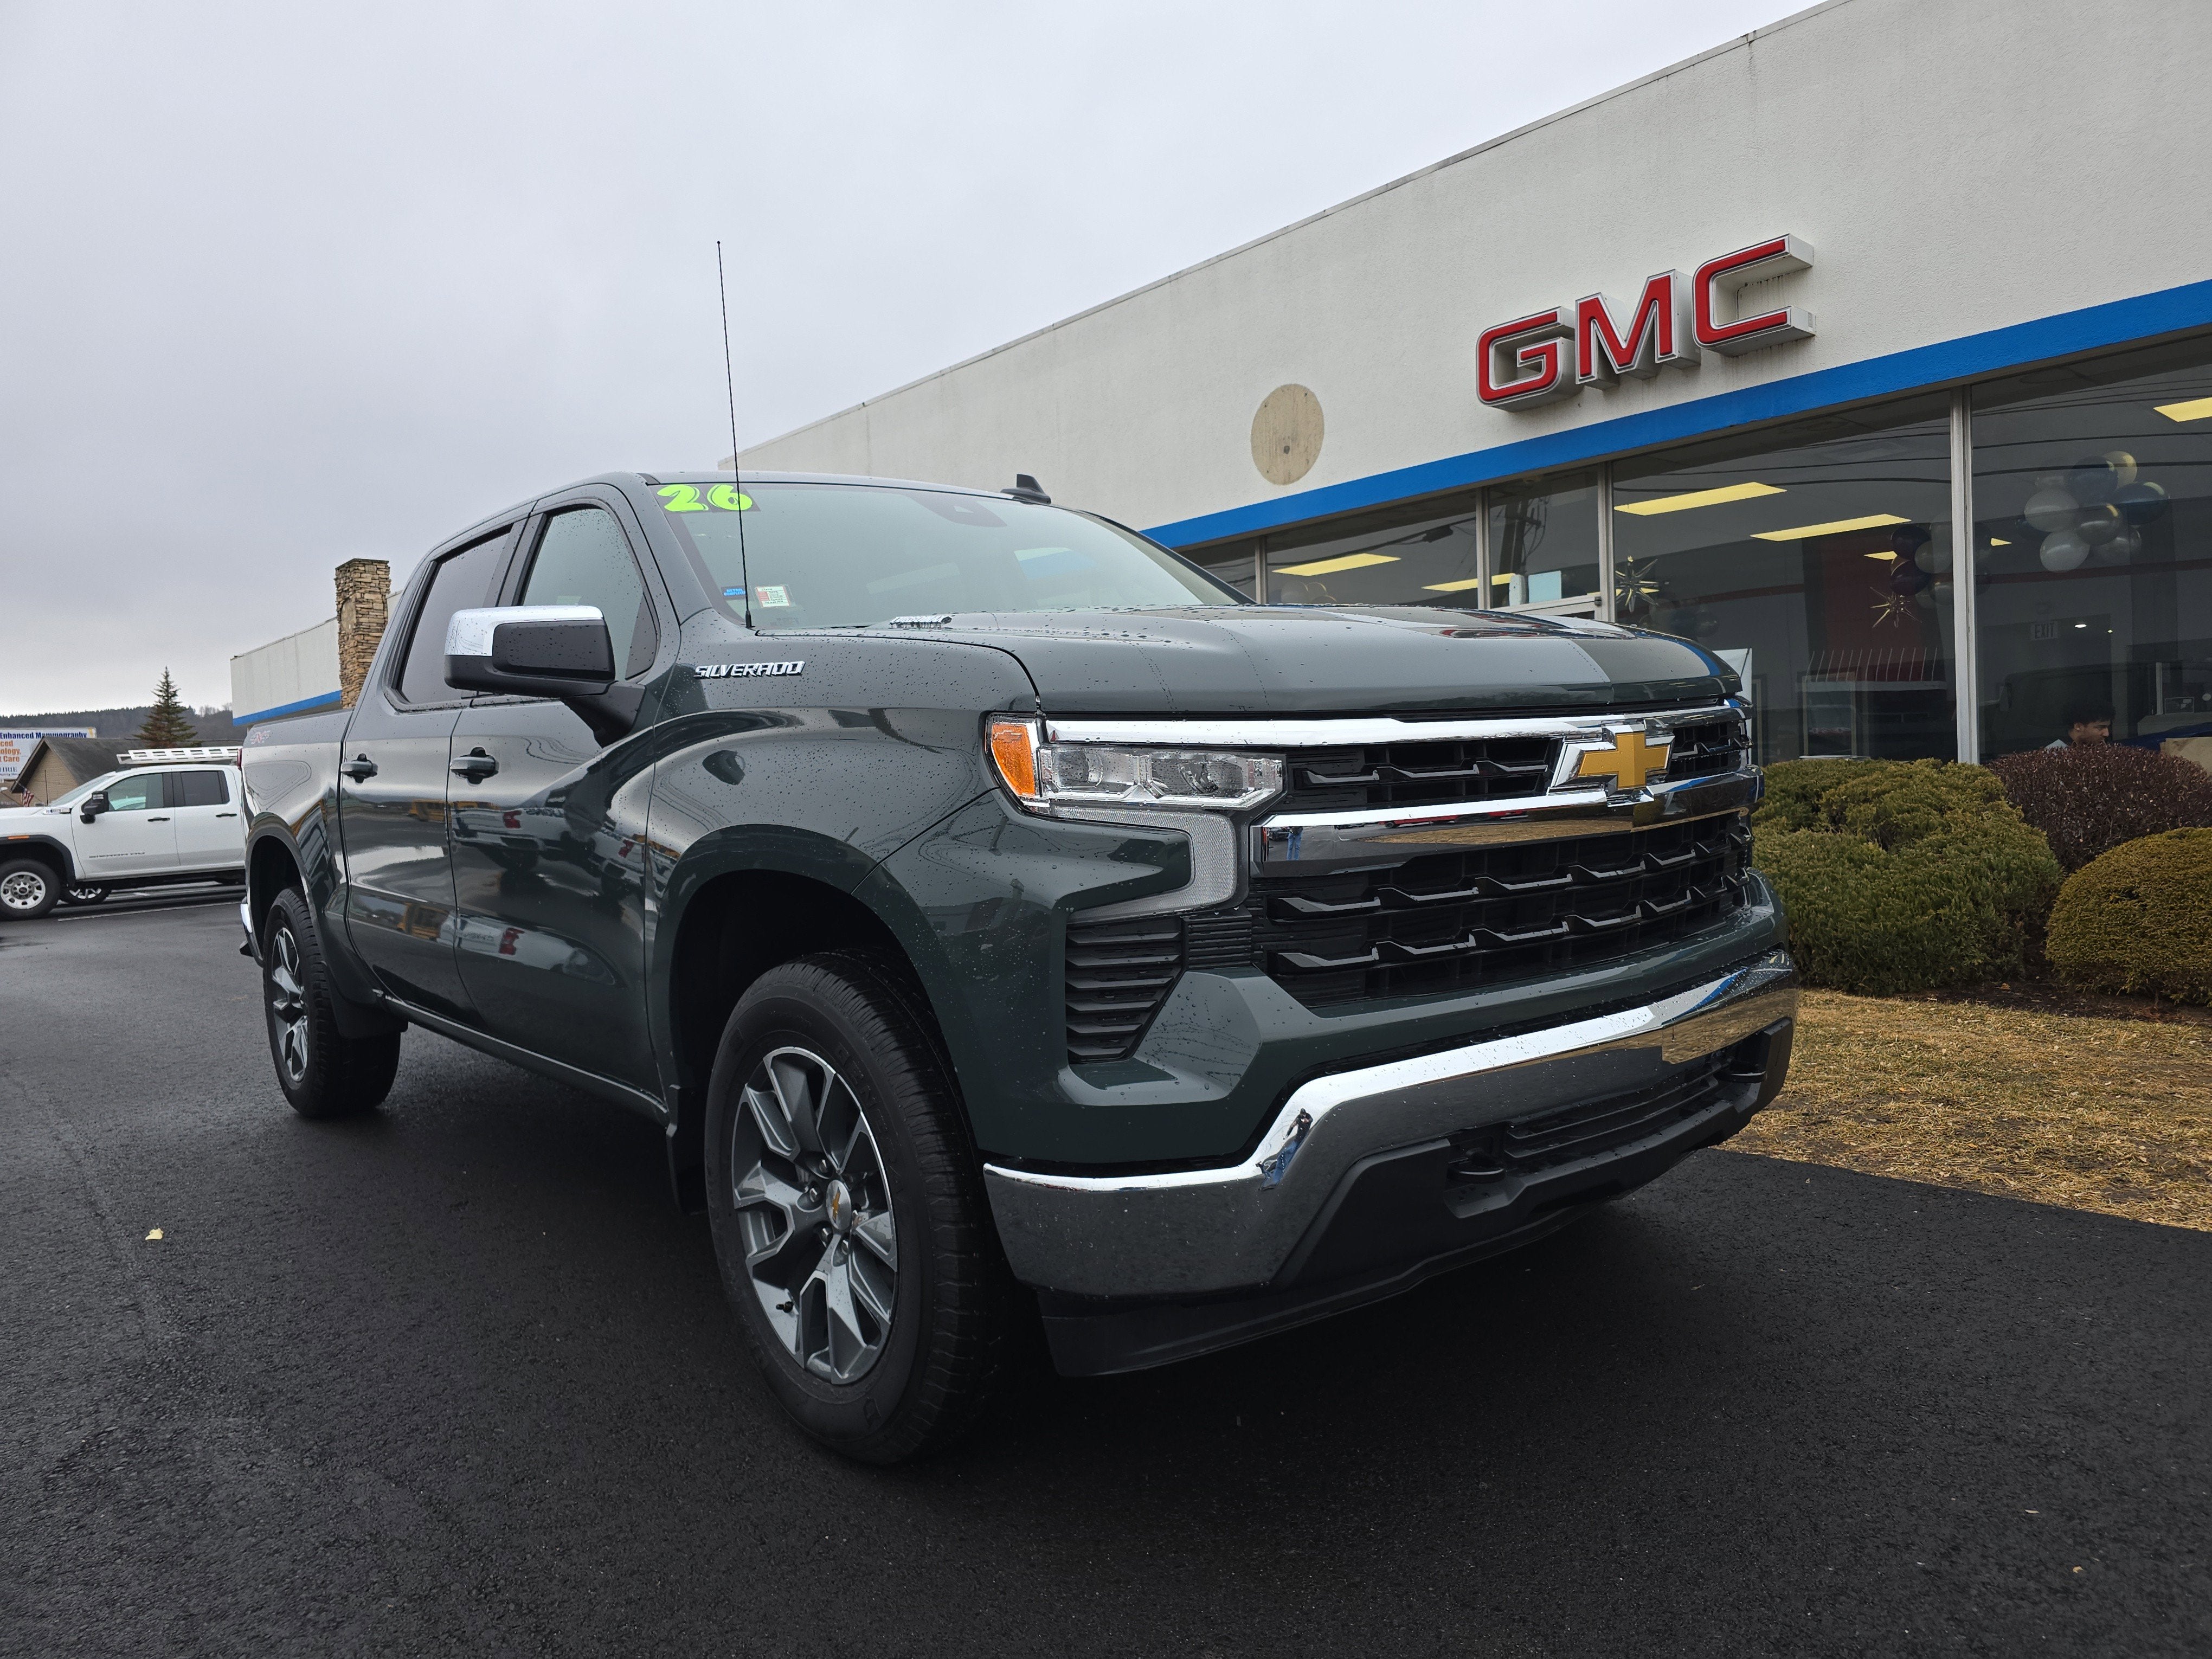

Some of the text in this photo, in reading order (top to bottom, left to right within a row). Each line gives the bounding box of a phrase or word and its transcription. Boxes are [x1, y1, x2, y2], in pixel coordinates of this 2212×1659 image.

[1476, 233, 1803, 409] GMC
[657, 484, 753, 512] 26
[2034, 623, 2054, 639] EXIT
[694, 661, 805, 678] SILVERADO
